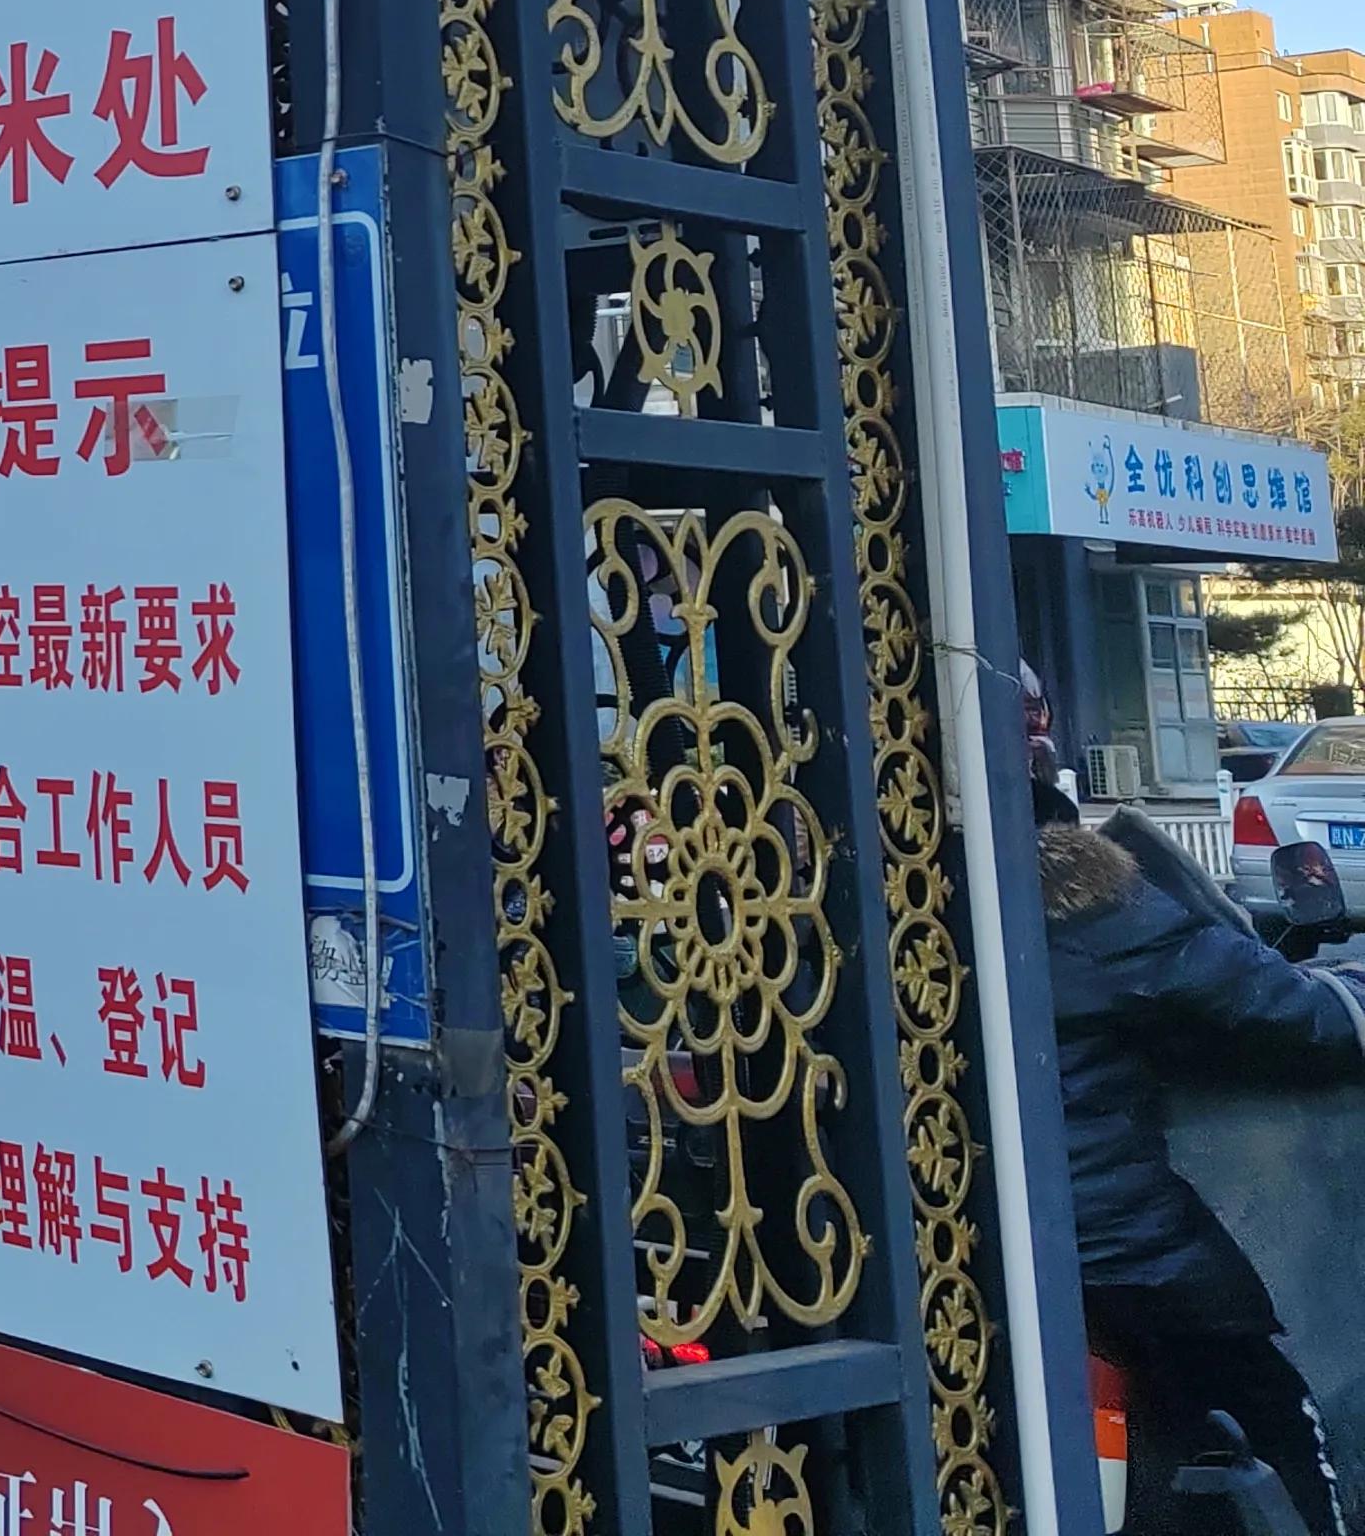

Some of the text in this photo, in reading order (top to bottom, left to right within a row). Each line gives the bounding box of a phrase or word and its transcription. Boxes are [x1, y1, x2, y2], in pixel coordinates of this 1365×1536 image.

[1124, 444, 1313, 514] 全优科创思维馆
[1128, 508, 1174, 531] 乐高机器人
